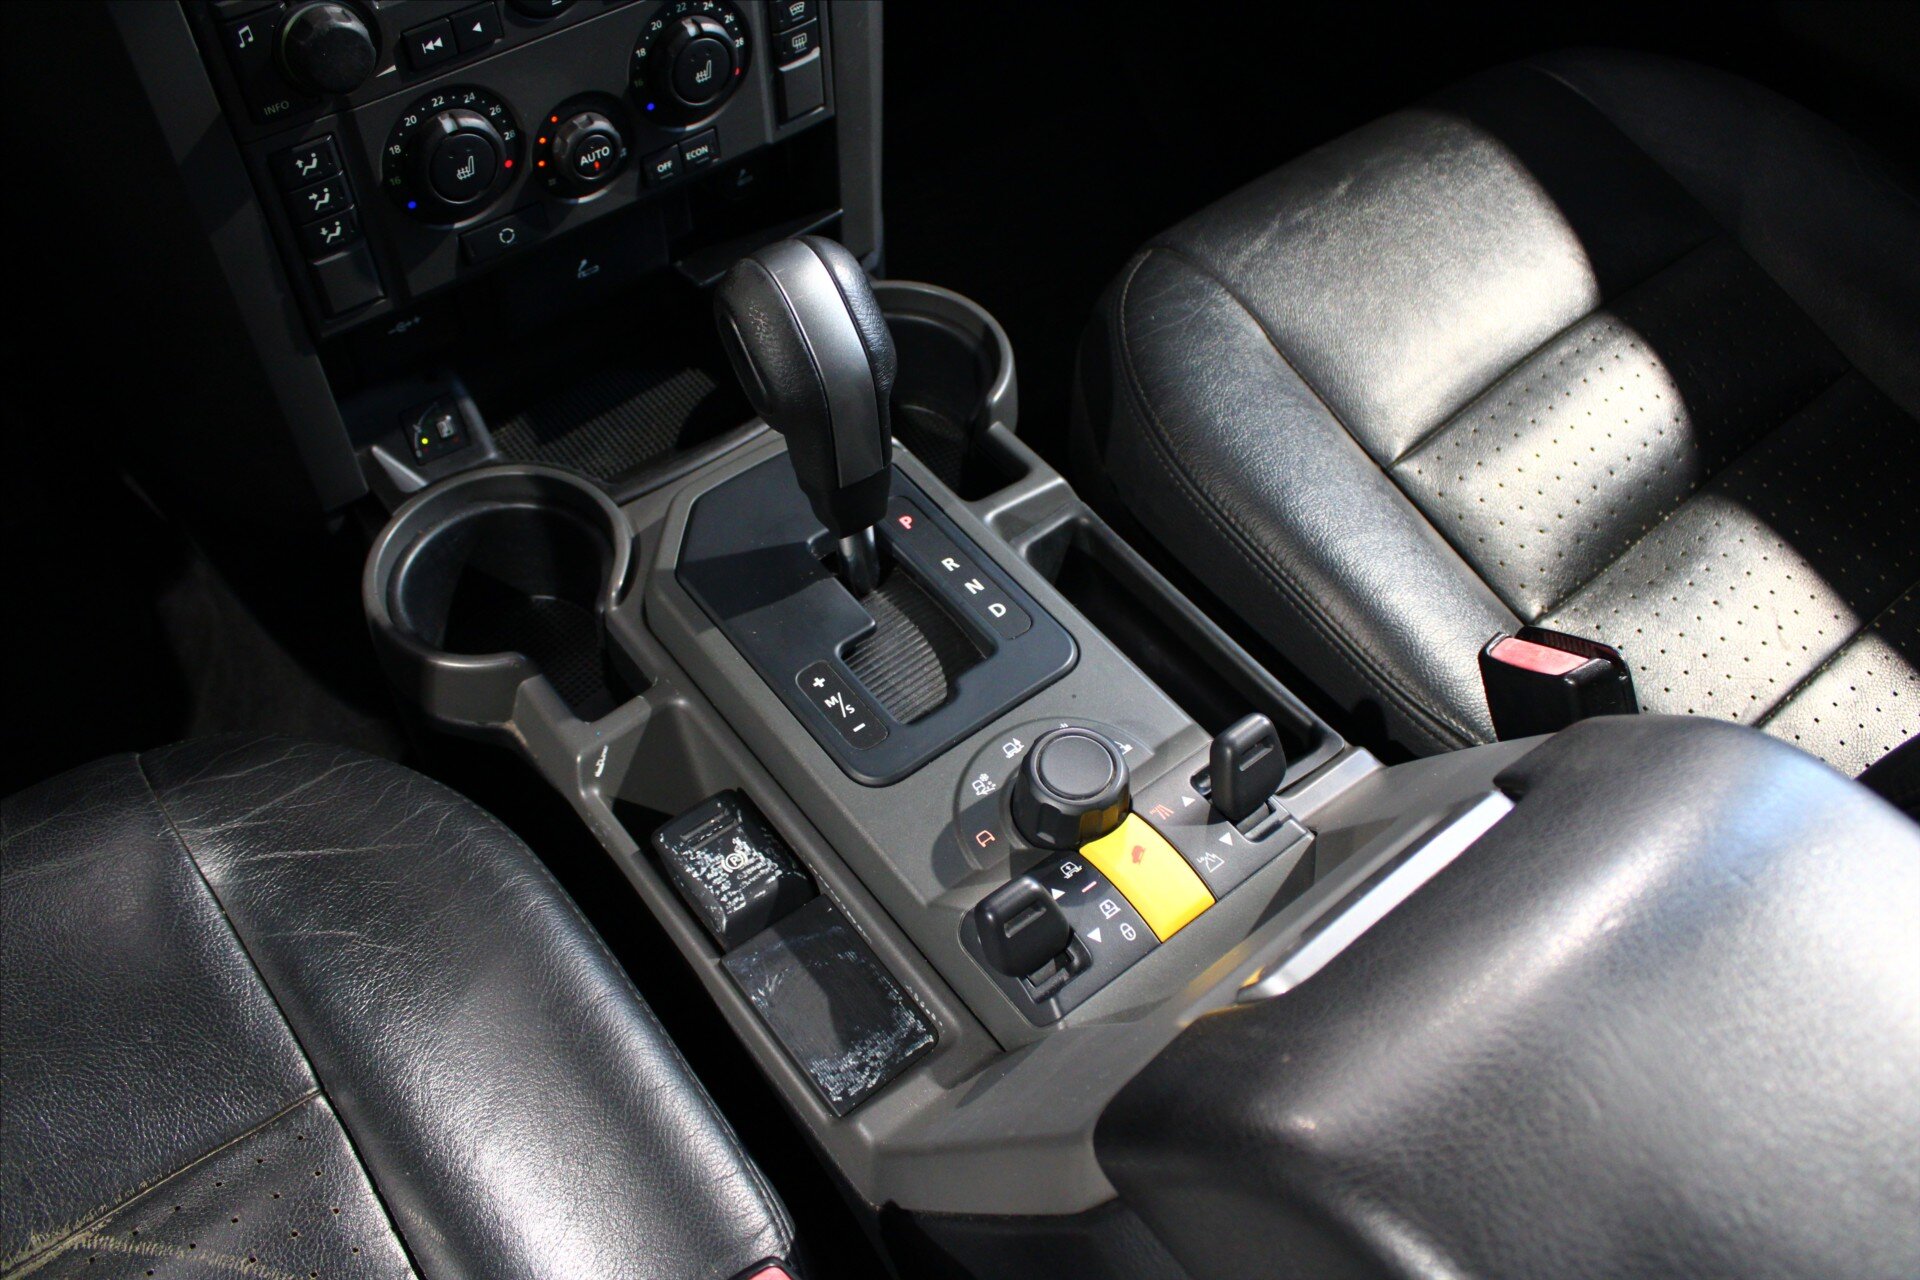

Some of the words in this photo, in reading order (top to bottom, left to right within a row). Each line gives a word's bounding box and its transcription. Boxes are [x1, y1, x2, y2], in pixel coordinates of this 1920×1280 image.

[635, 47, 647, 59] 18
[650, 19, 663, 32] 20
[675, 2, 688, 14] 22
[702, 0, 715, 11] 24
[723, 12, 735, 24] 26
[734, 36, 745, 48] 28
[263, 99, 290, 117] INFO
[388, 144, 402, 156] 18
[403, 114, 418, 128] 20
[431, 95, 445, 108] 22
[463, 91, 476, 104] 24
[488, 103, 502, 117] 26
[503, 129, 517, 141] 28
[579, 145, 611, 167] AUTO
[685, 144, 709, 161] ECON
[656, 159, 673, 174] OFF
[898, 515, 914, 530] P
[941, 556, 961, 573] R
[964, 577, 986, 595] N
[987, 602, 1007, 618] D
